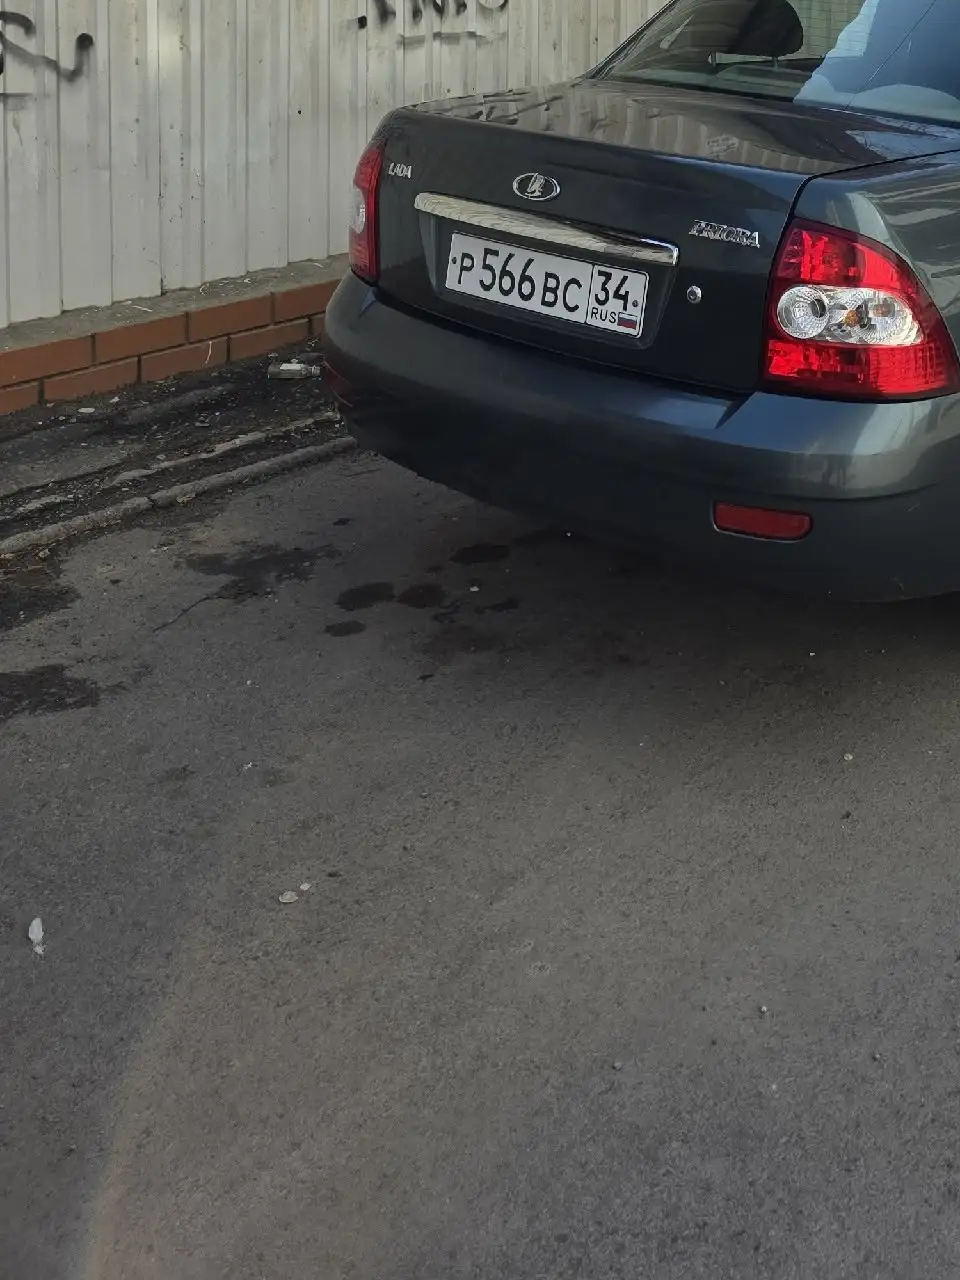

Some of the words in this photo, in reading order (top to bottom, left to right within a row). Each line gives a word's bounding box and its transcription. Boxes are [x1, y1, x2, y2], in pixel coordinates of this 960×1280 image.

[388, 162, 413, 179] LADA
[688, 219, 761, 249] PRIORA
[594, 269, 630, 312] 34
[590, 306, 617, 324] RUS
